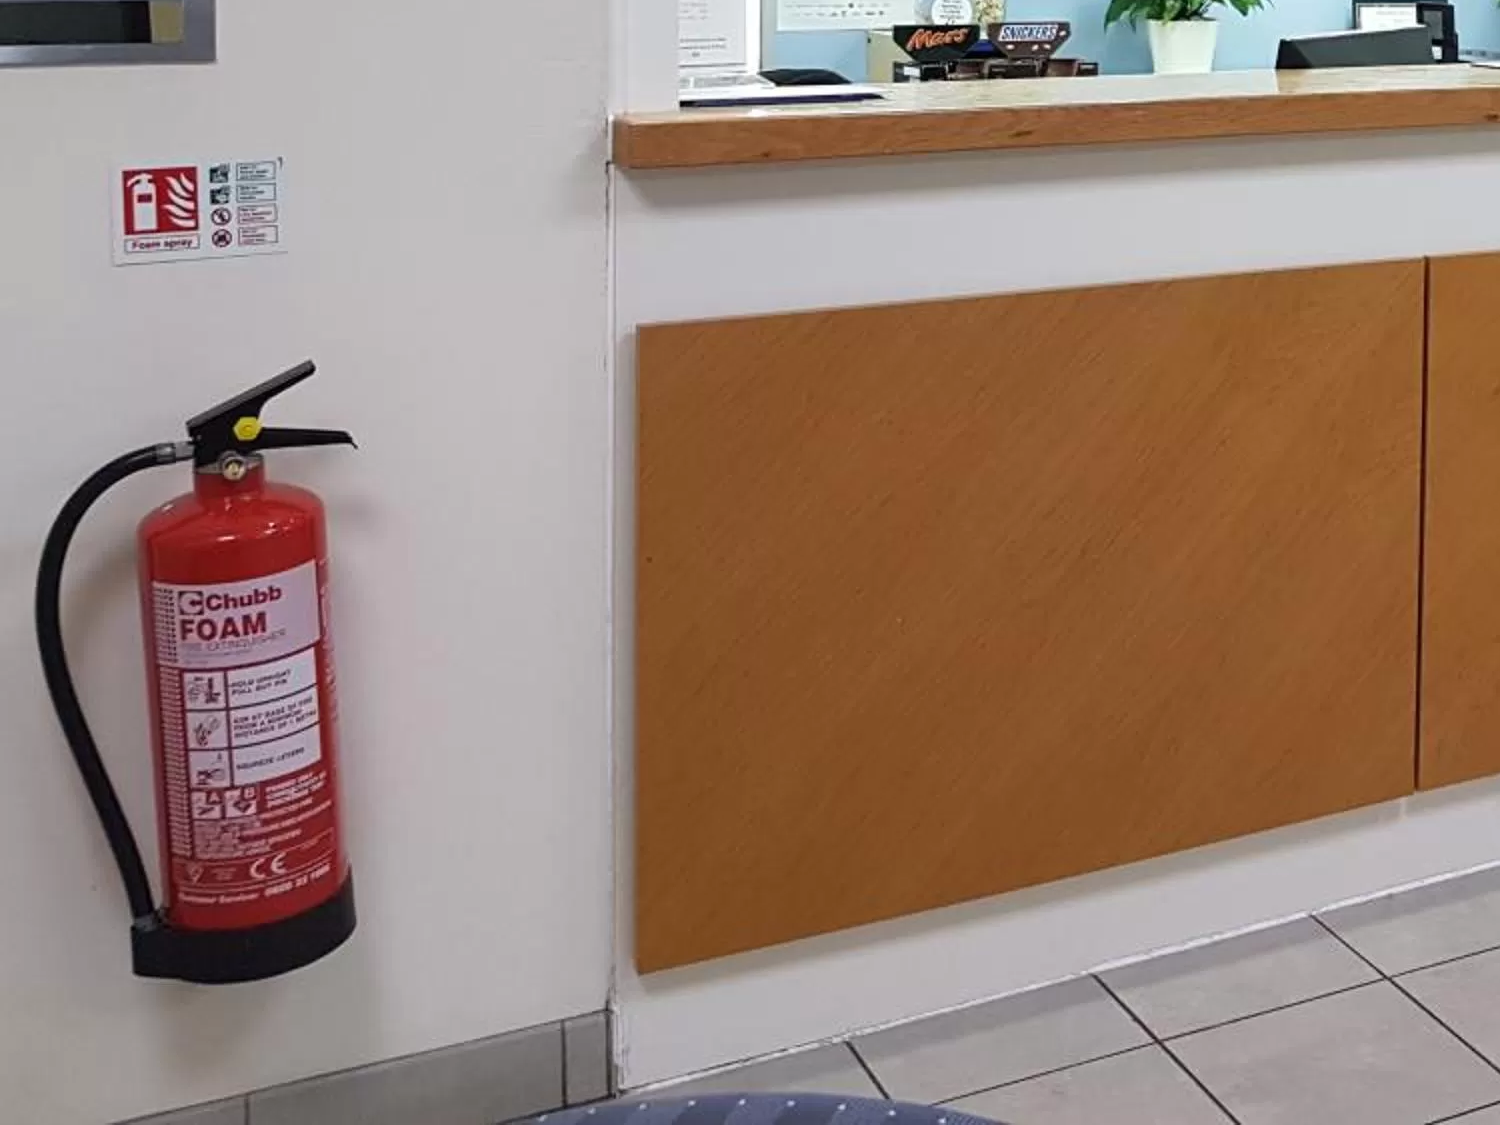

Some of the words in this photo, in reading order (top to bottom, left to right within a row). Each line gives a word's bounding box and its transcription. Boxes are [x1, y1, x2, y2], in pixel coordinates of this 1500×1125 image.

[906, 27, 970, 52] Mars
[1001, 26, 1058, 41] SNICKERS
[205, 585, 282, 611] Chubb
[180, 611, 267, 642] FOAM
